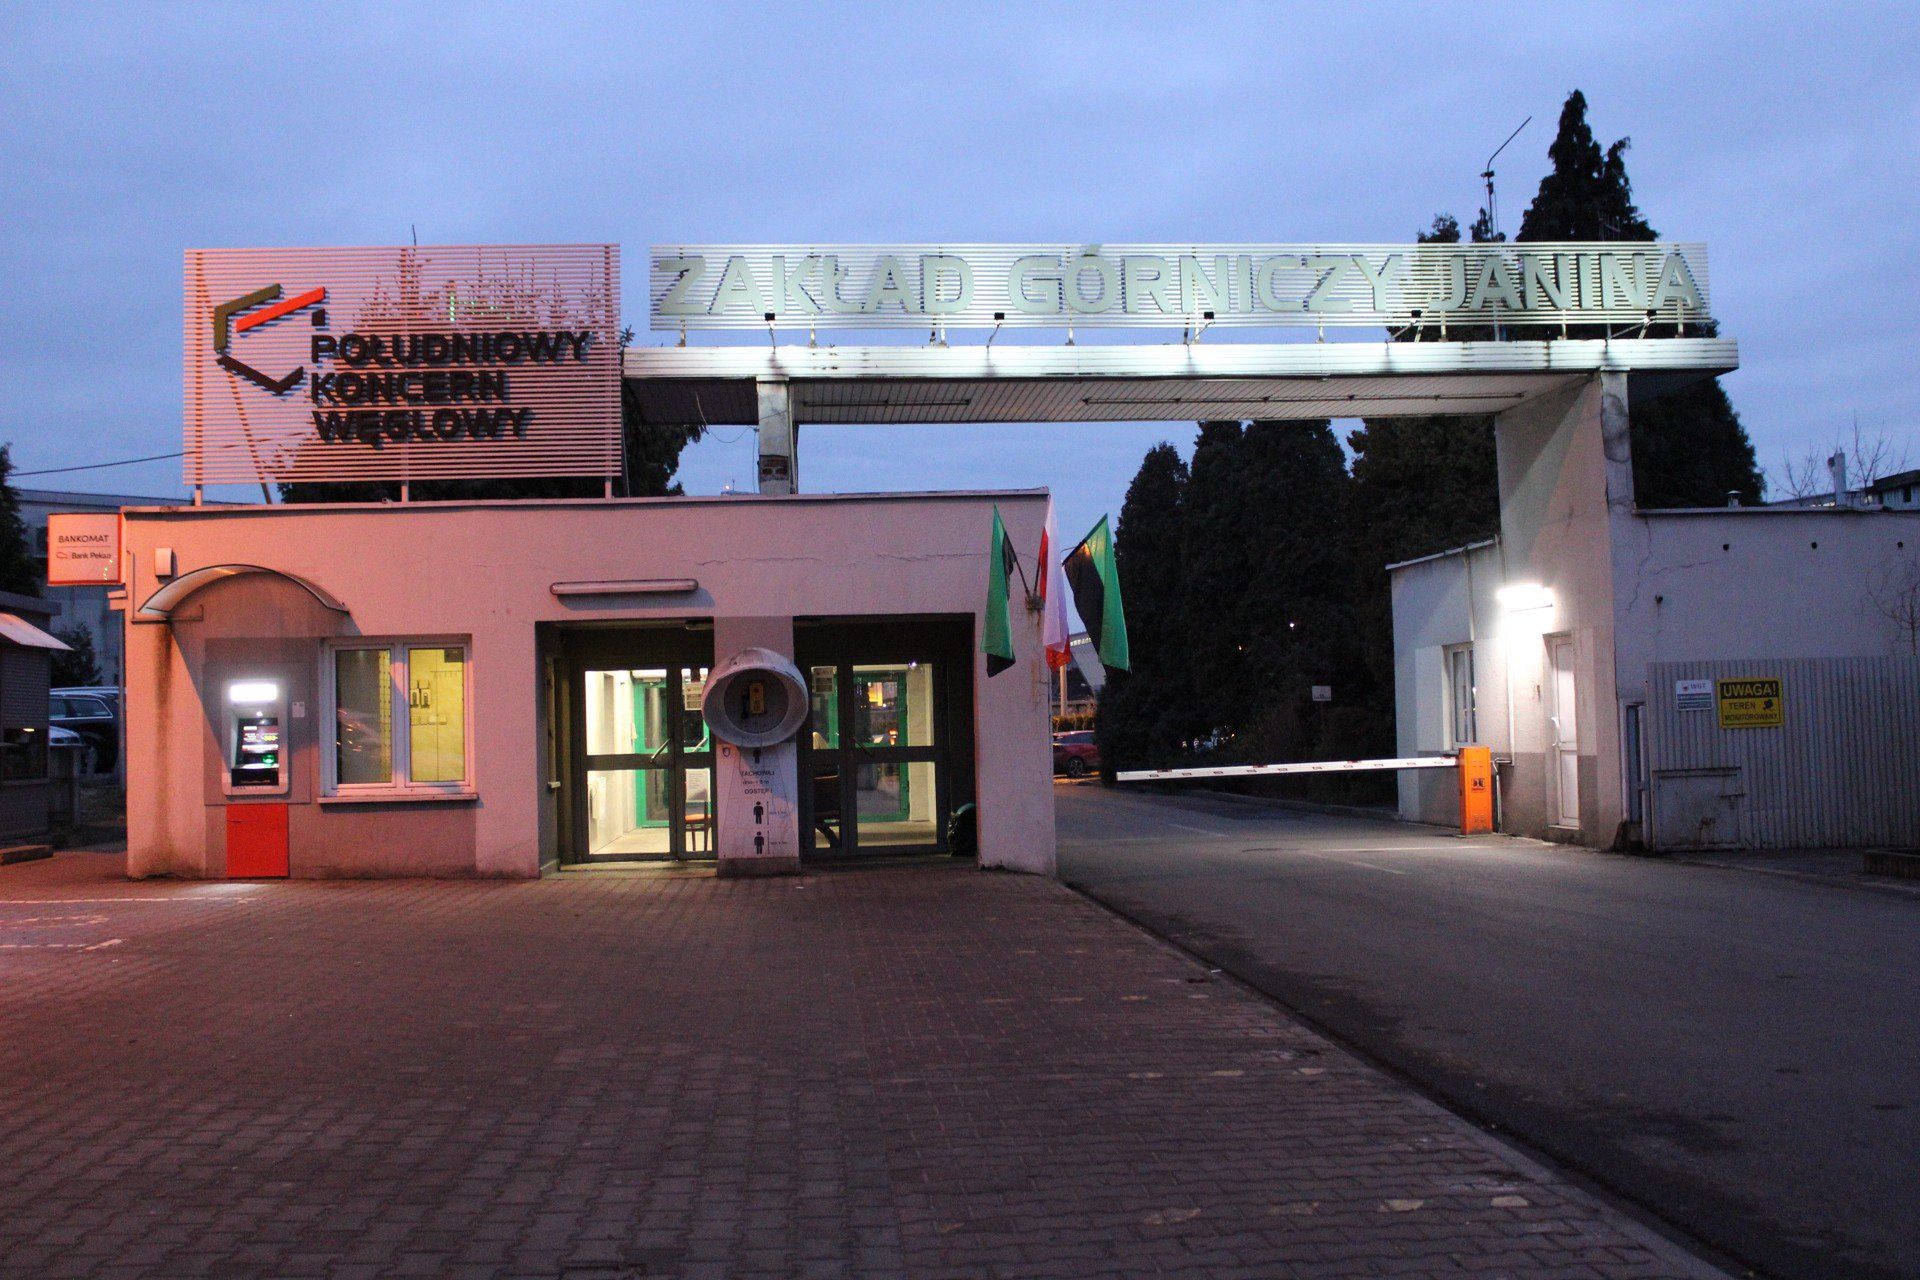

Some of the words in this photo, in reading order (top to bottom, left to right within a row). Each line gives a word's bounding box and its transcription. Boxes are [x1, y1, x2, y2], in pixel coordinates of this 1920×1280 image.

[658, 253, 976, 315] ZAKŁAD
[1007, 244, 1403, 314] GÓRNICZY
[1427, 252, 1701, 312] JANINA
[311, 332, 591, 364] POŁUDNIOWY
[311, 369, 510, 403] KONCERN
[311, 407, 532, 450] WĘGLOWY
[58, 535, 109, 543] BANKOMAT
[90, 551, 112, 559] Pekao
[1723, 684, 1777, 697] UWAGA!
[1729, 701, 1756, 710] TEREN
